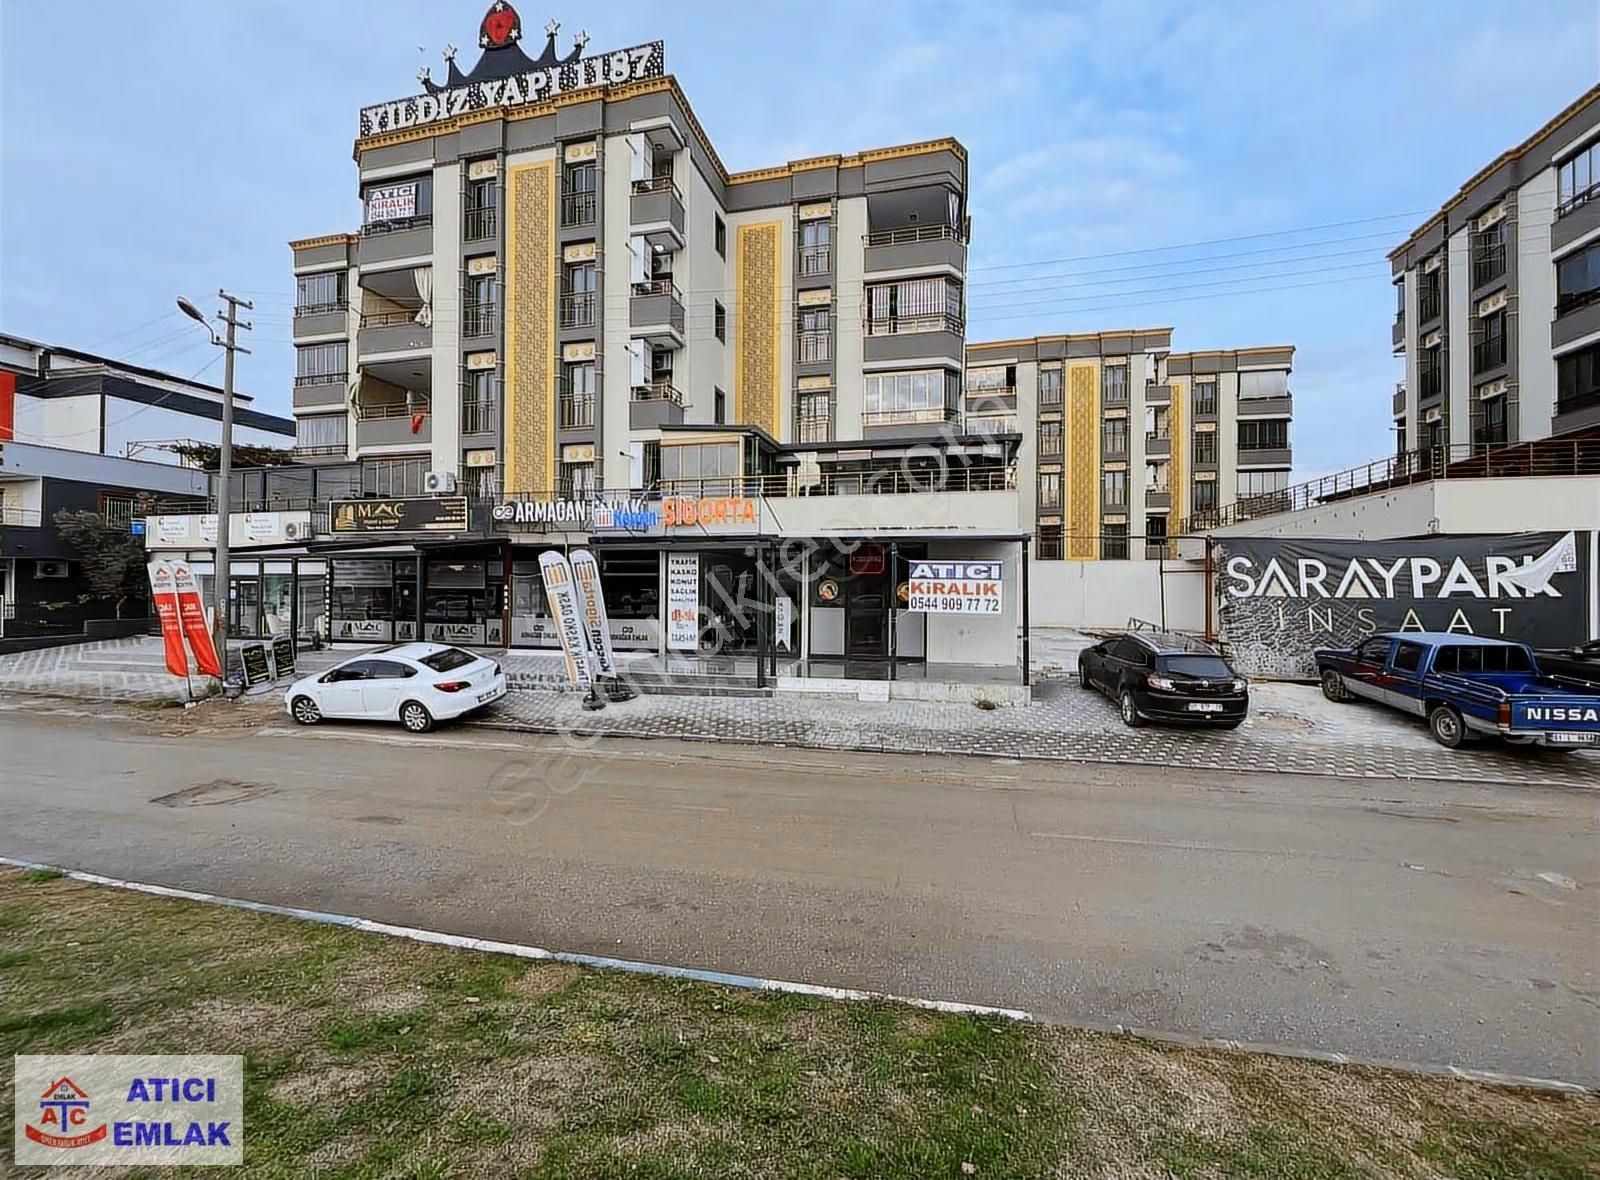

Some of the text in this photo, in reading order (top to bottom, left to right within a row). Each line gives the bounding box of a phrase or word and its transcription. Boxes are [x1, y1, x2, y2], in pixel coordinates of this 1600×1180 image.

[366, 45, 653, 135] YILDIZ YAPI 1187
[371, 185, 415, 200] ATICI
[515, 498, 586, 522] ARMAĞAN
[911, 563, 1000, 579] ATICI
[910, 597, 999, 611] 0544 909 77 72
